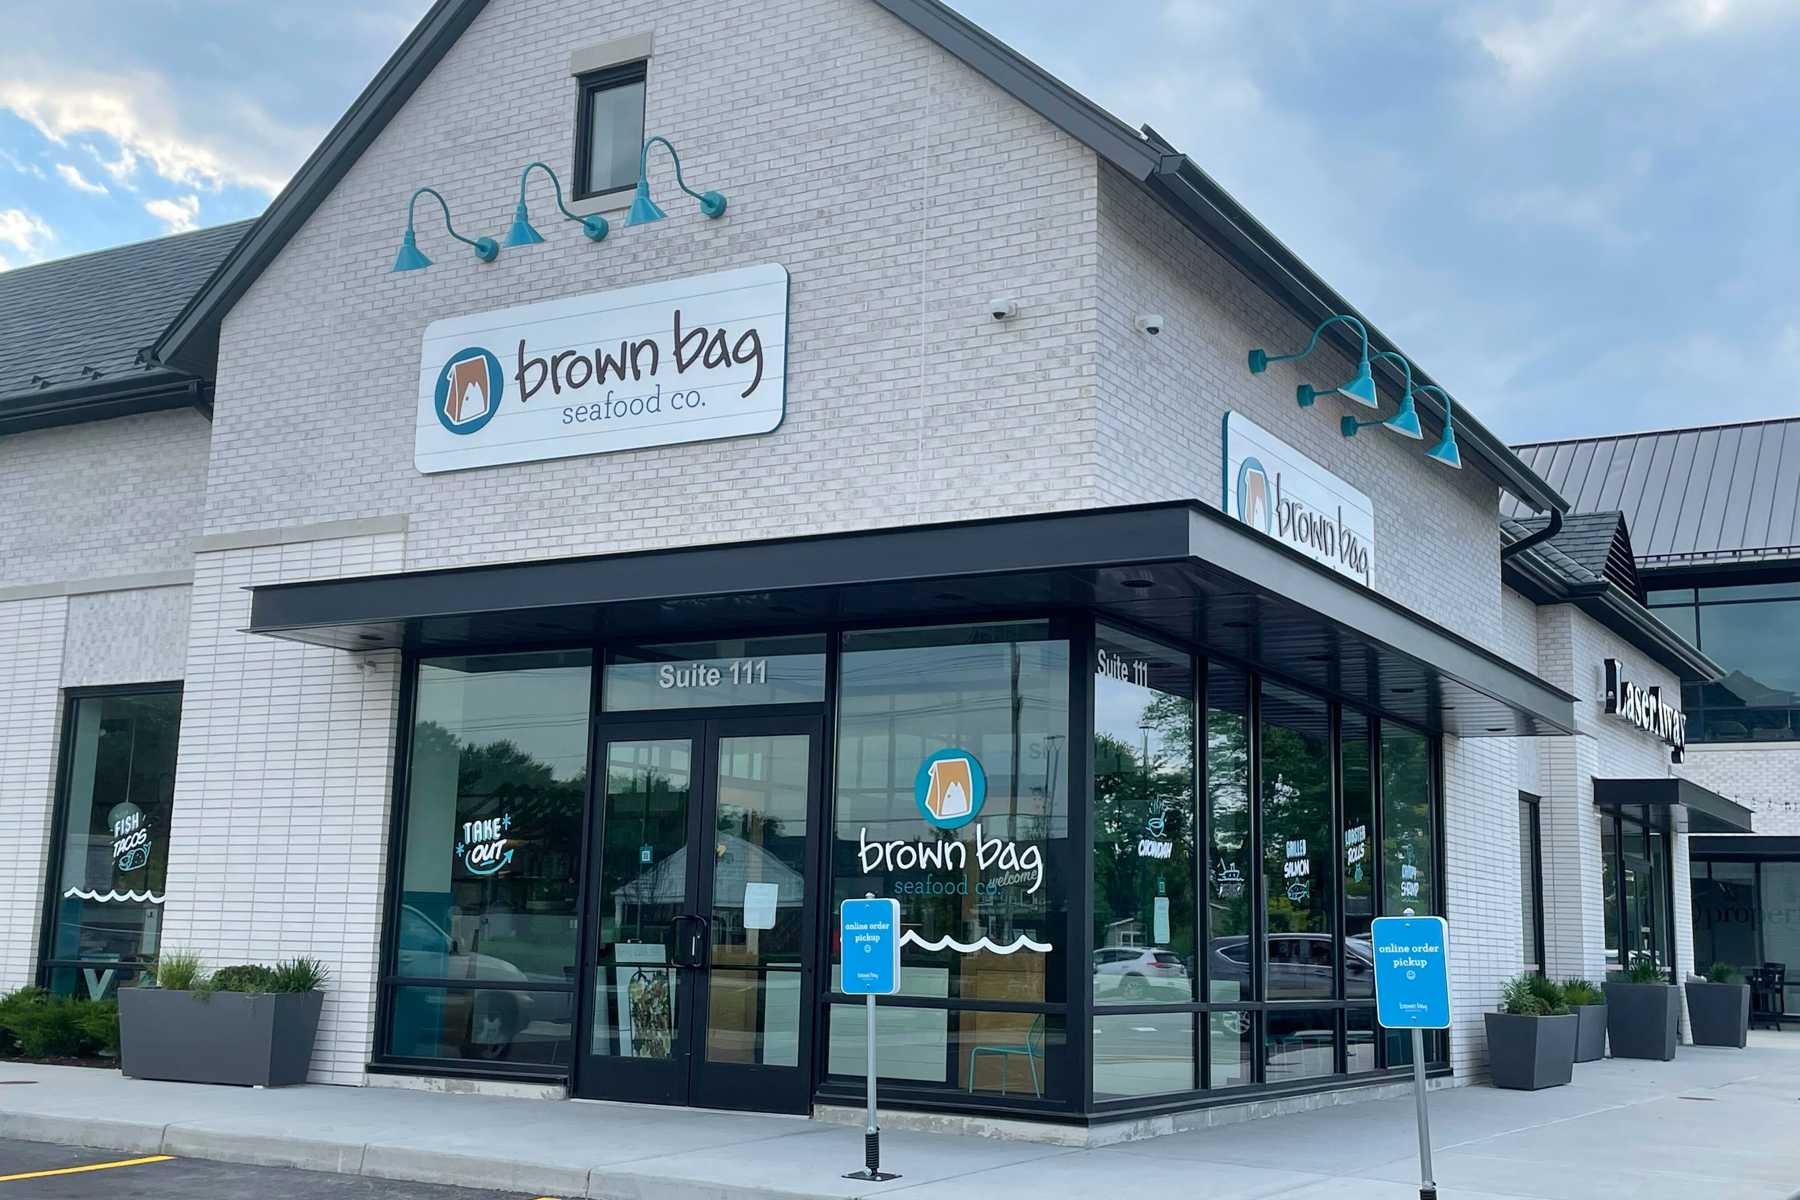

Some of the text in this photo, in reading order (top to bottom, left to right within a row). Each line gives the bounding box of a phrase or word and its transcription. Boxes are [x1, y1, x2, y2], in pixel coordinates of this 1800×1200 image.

[515, 309, 764, 402] brown bag
[562, 384, 706, 424] seafood co.
[1276, 472, 1370, 587] brown bag
[659, 659, 767, 688] Suite 111
[1097, 649, 1149, 688] Suite 111
[1603, 659, 1687, 764] LaserAway
[114, 812, 139, 837] FISH
[463, 817, 501, 845] TAKE
[113, 828, 148, 858] TACOS
[471, 839, 507, 863] OUT
[858, 823, 1043, 894] brown bag
[1284, 859, 1310, 878] SALMON
[894, 873, 968, 895] seafood
[989, 870, 1038, 889] welcome
[845, 921, 890, 930] online order
[855, 933, 880, 943] pickup
[1379, 943, 1440, 953] online order
[1393, 957, 1428, 969] pickup
